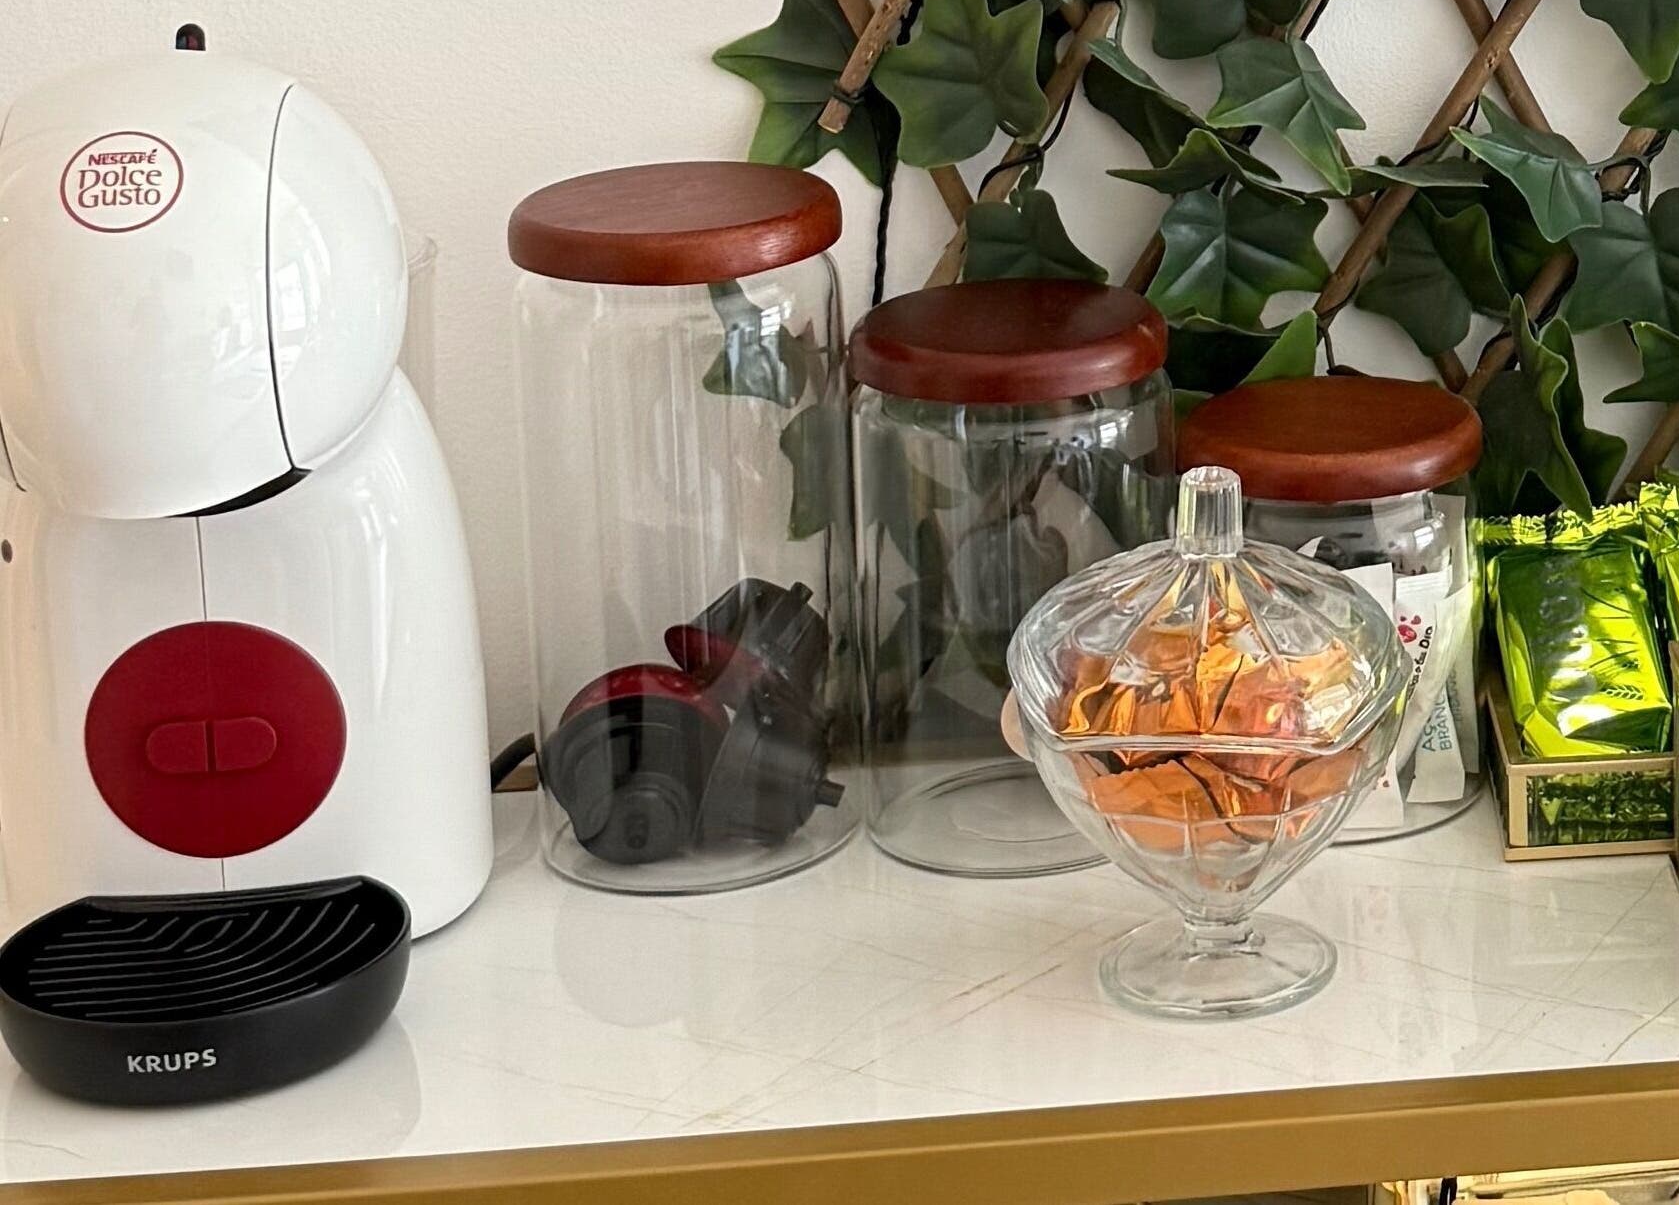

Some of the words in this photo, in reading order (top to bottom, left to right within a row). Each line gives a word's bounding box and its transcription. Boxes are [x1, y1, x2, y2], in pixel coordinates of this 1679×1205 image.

[88, 149, 157, 166] NESCAFÉ
[78, 166, 162, 189] Dolce
[78, 187, 161, 208] Gusto
[127, 1048, 217, 1073] KRUPS
